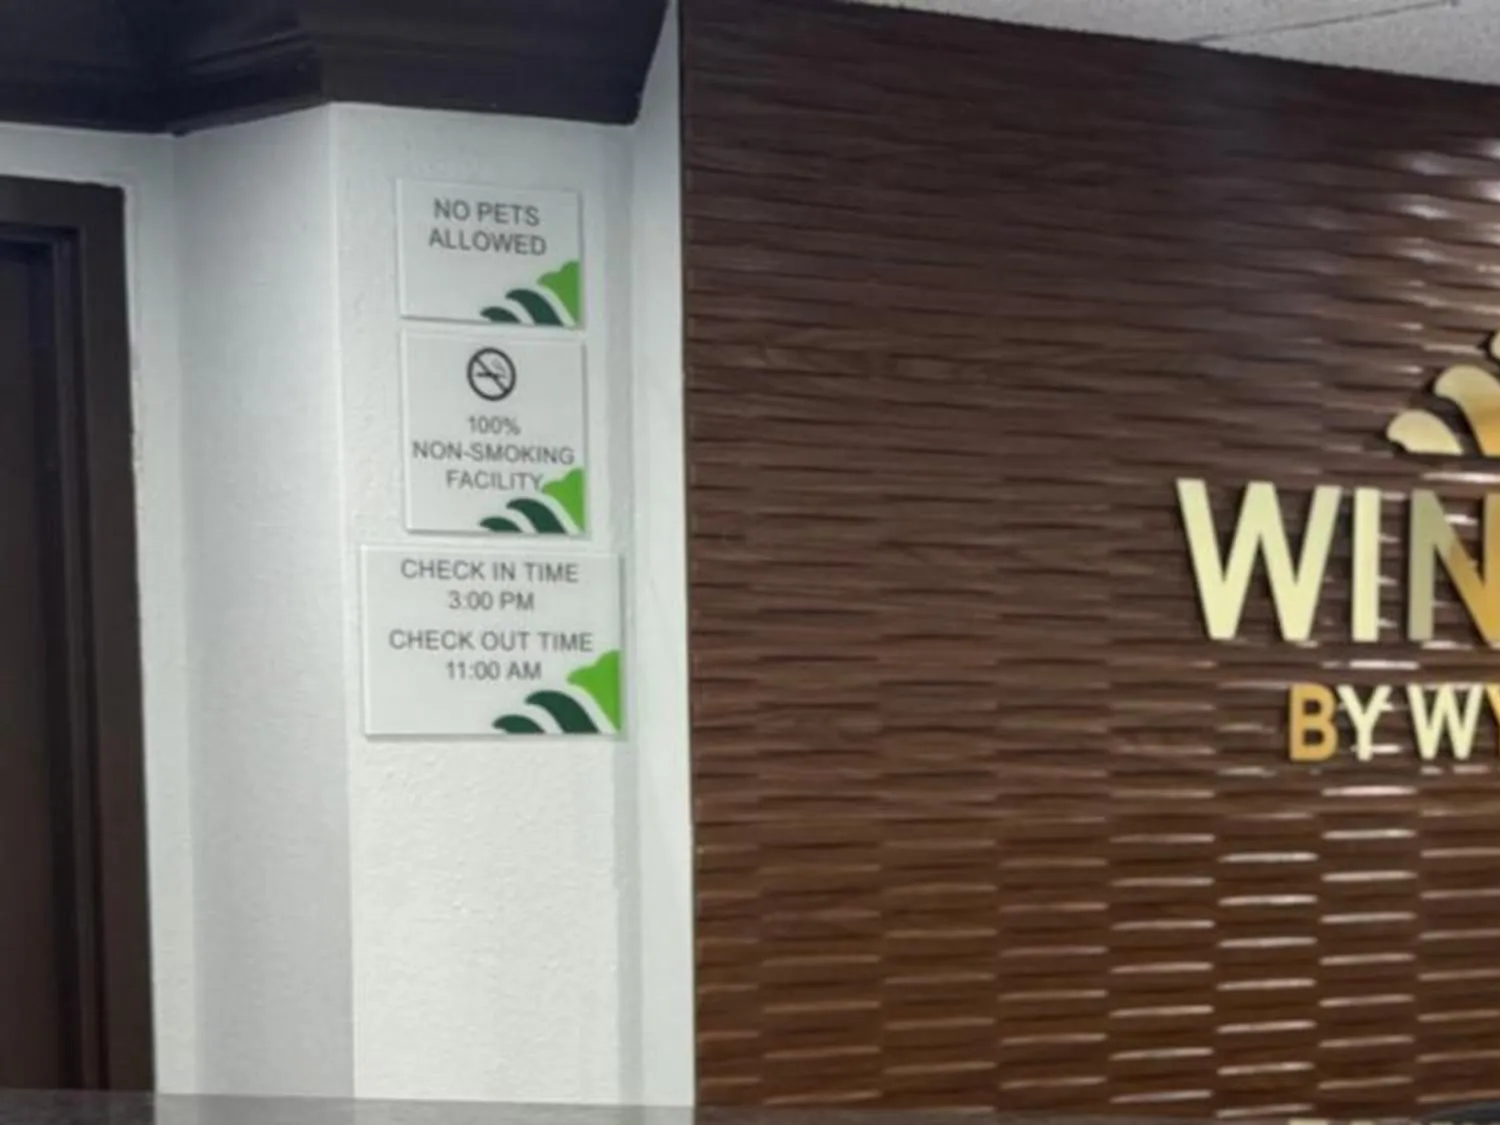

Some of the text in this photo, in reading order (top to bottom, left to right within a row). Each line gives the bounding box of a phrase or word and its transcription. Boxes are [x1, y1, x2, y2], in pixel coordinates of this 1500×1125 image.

[434, 198, 540, 227] NO PETS
[428, 228, 547, 256] ALLOWED
[468, 415, 521, 436] 100%
[412, 440, 575, 466] NON-SMOKING
[446, 469, 544, 491] FACILITY
[400, 558, 579, 583] CHECK IN TIME
[448, 590, 535, 611] 3:00 PM
[388, 629, 593, 652] CHECK OUT TIME
[446, 660, 542, 681] 11:00 AM
[1288, 681, 1392, 761] BY
